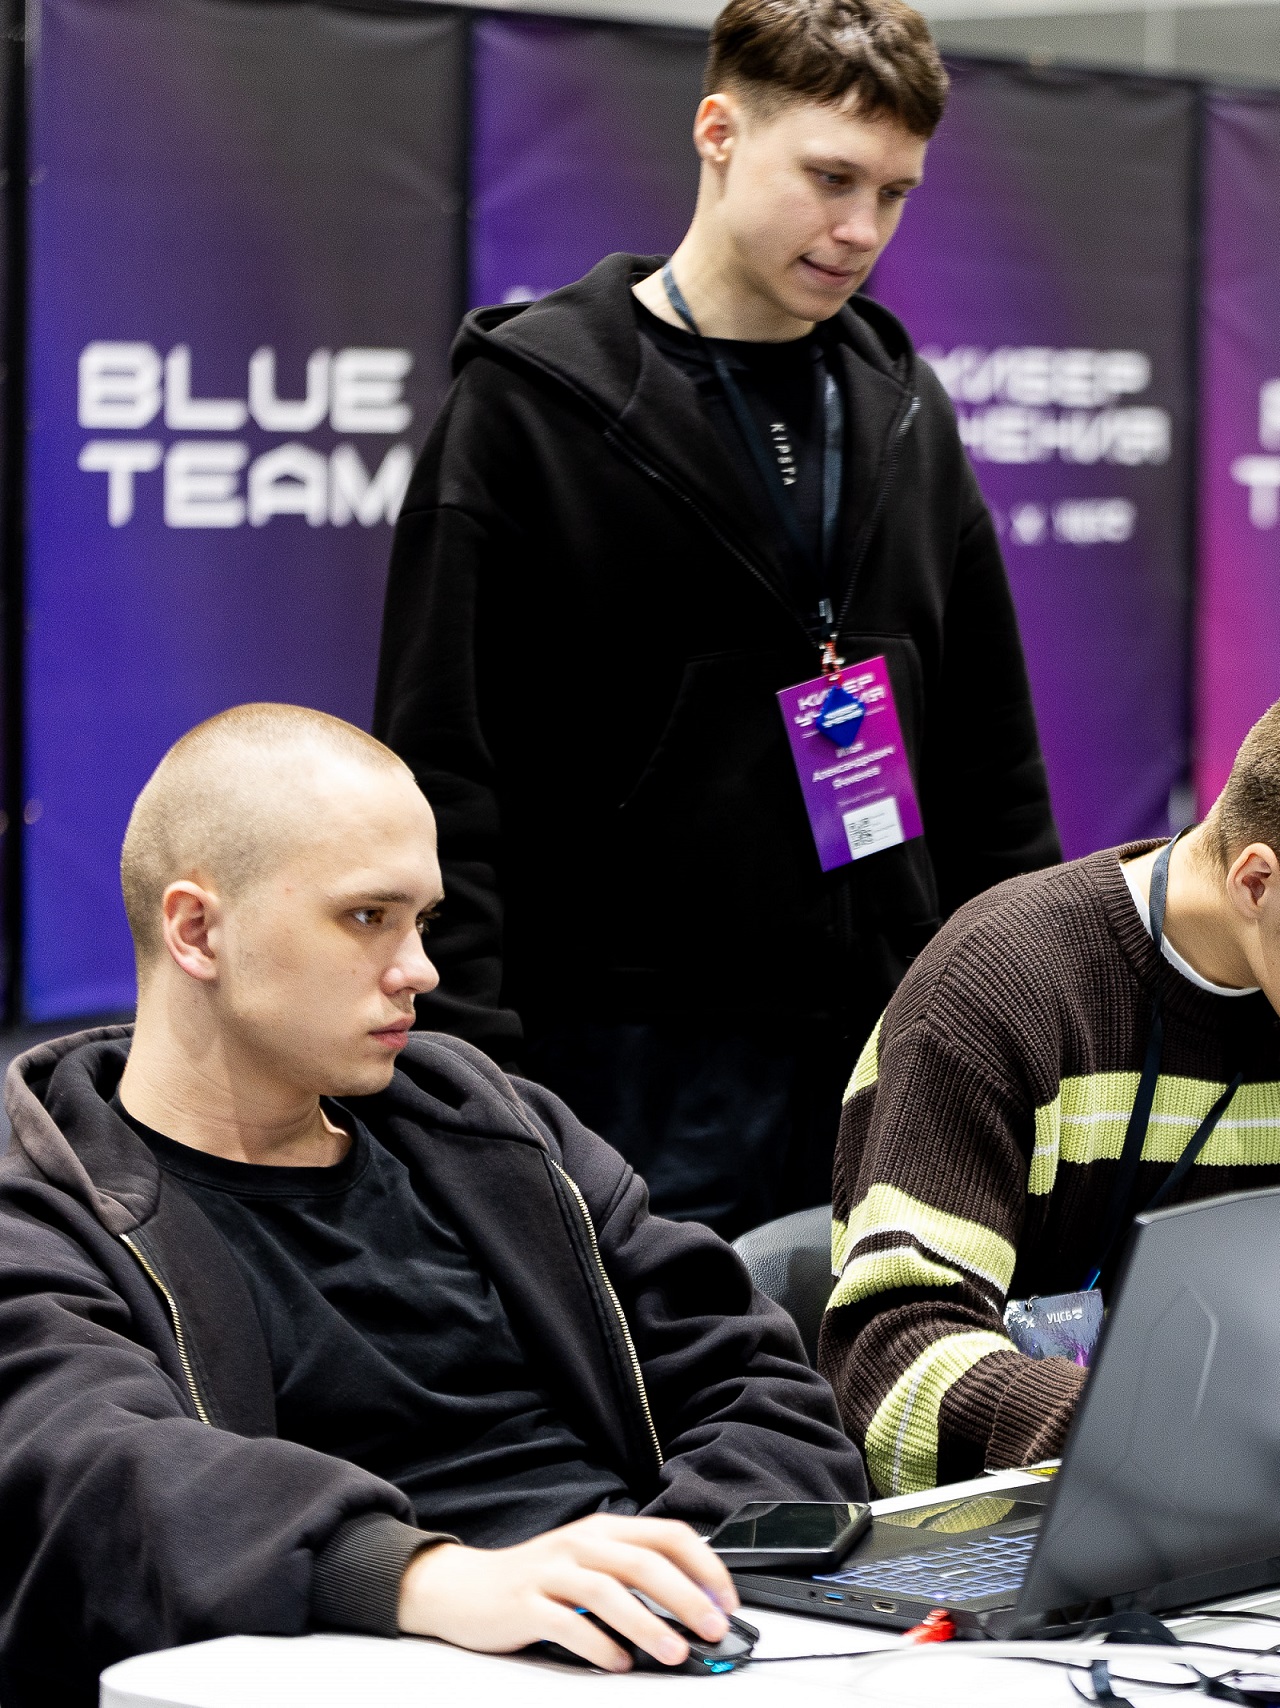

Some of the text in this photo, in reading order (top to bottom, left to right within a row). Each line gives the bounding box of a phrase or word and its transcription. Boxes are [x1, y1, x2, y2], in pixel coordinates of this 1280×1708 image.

[79, 341, 412, 432] BLUE
[770, 424, 797, 486] KIPSTA
[956, 407, 1171, 464] ЧЕНИЯ
[79, 440, 412, 528] TEAM
[797, 673, 874, 710] КИЕР
[1046, 1311, 1073, 1324] УЦСБ
